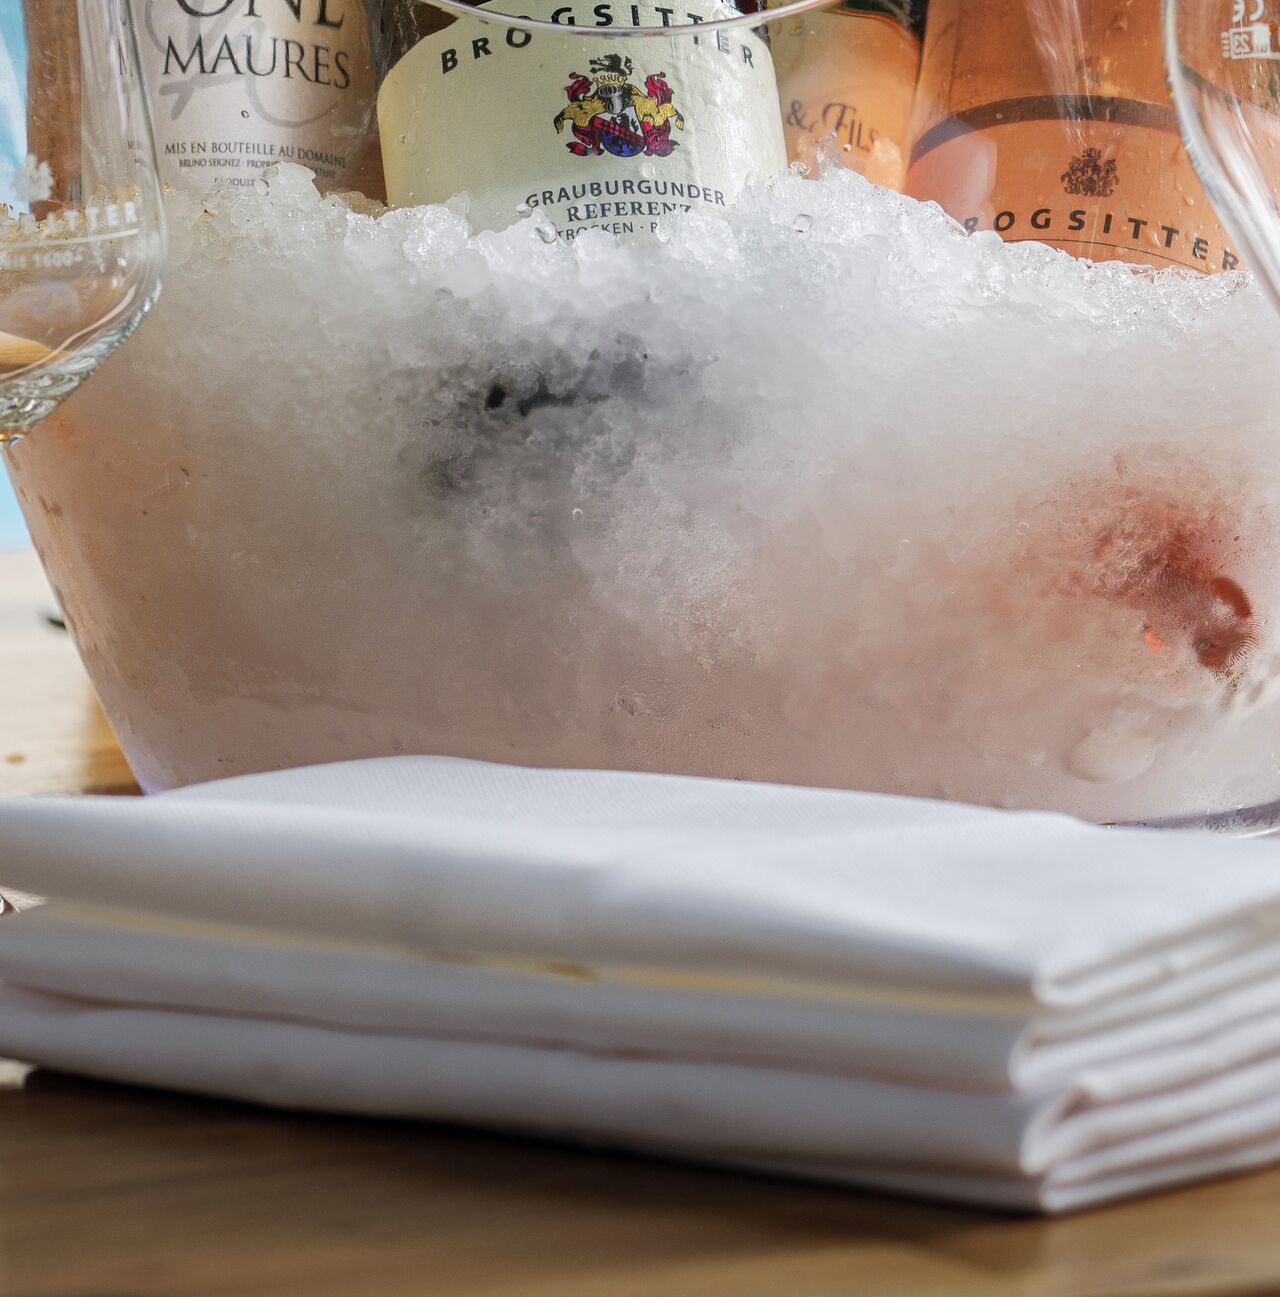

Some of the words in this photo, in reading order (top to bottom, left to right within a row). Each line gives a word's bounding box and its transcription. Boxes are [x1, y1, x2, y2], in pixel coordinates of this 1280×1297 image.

[162, 36, 351, 90] MAURES
[439, 3, 756, 75] BROGSITTER
[164, 142, 186, 155] MIS
[190, 142, 207, 154] EN
[210, 142, 275, 156] BOUTEILLE
[278, 145, 295, 159] AU
[297, 147, 347, 169] DOMAINE
[525, 179, 726, 209] GRAUBURGUNDER
[963, 208, 1240, 271] ROGSITTER
